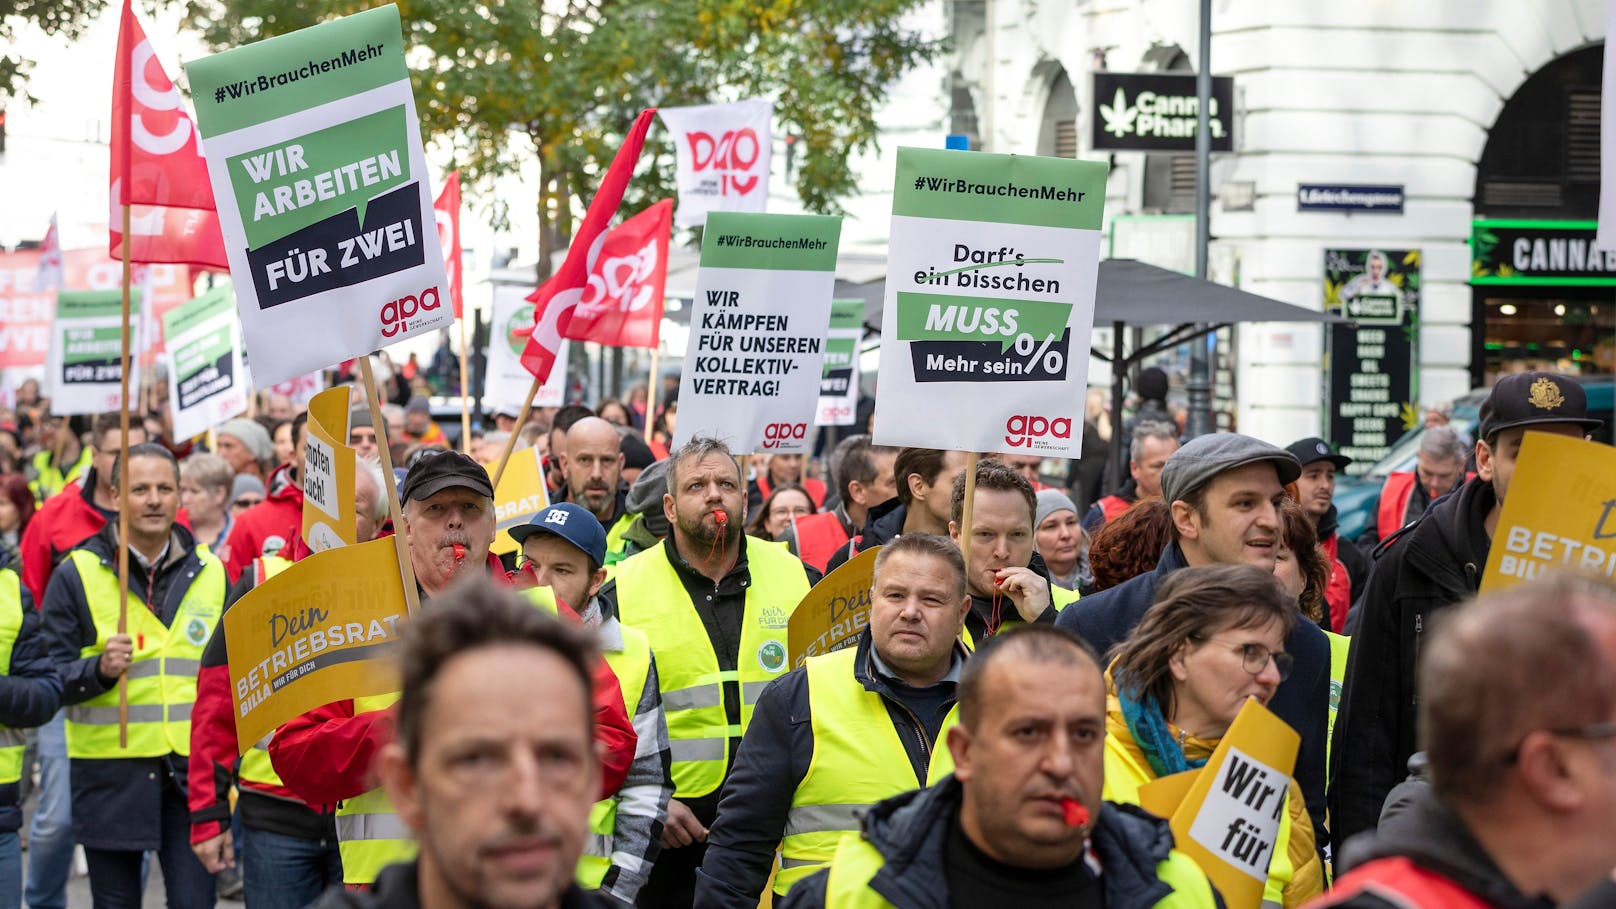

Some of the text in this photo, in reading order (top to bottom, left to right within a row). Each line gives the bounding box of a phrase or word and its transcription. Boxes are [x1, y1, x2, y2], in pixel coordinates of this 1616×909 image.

[215, 42, 384, 104] #WirBrauchenMehr
[241, 144, 309, 184] WIR
[254, 150, 401, 222] ARBEITEN
[914, 176, 1086, 203] #WirBrauchenMehr
[265, 248, 331, 291] FÜR
[337, 218, 416, 269] ZWEI
[717, 235, 828, 250] #WirBrauchenMehr
[914, 266, 1060, 294] ein bisschen
[381, 285, 440, 337] gpa
[706, 290, 740, 308] WIR
[701, 309, 788, 332] KÄMPFEN
[925, 304, 1020, 336] MUSS
[698, 331, 821, 354] FÜR UNSEREN
[695, 357, 798, 375] KOLLEKTIV-
[926, 354, 978, 373] Mehr
[983, 358, 1022, 375] sein
[693, 379, 780, 397] VERTRAG!
[763, 423, 807, 448] gpa
[1005, 415, 1072, 448] gpa
[829, 589, 872, 624] Dei
[269, 607, 329, 648] Dein
[236, 613, 401, 700] BETRIEBSRAT
[273, 676, 286, 689] WIR
[299, 660, 316, 674] DICH
[240, 683, 272, 718] BILLA
[1222, 755, 1275, 812] Wir
[1220, 817, 1268, 866] für
